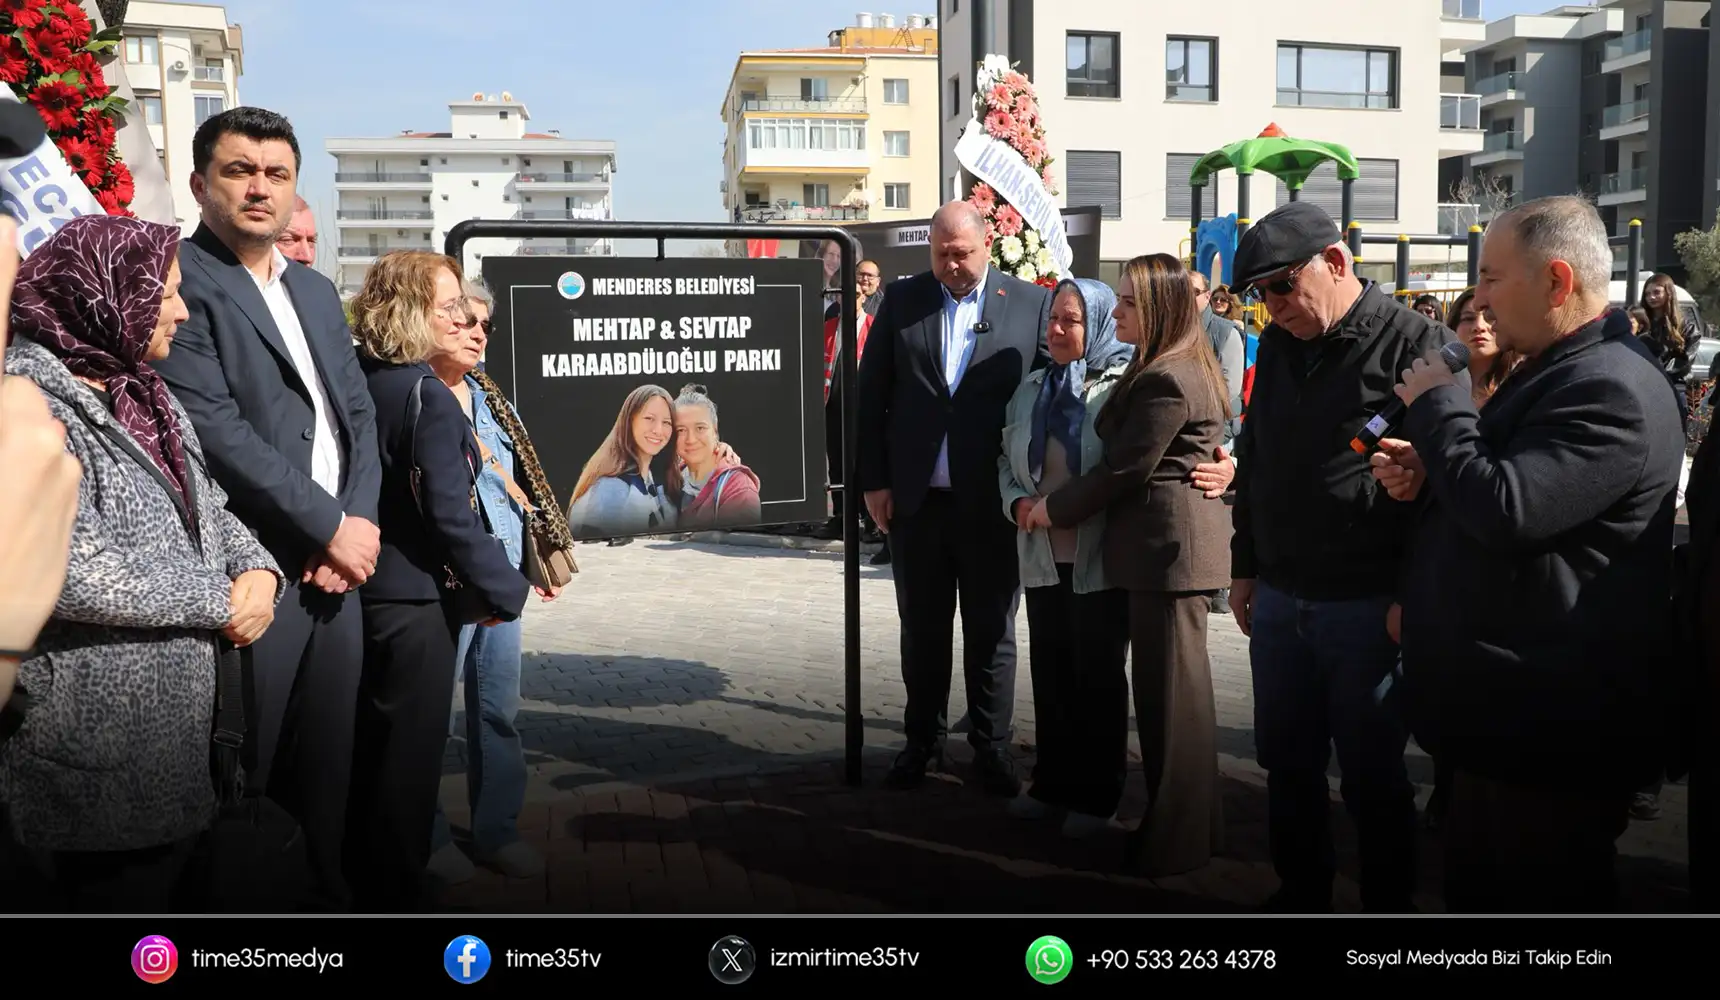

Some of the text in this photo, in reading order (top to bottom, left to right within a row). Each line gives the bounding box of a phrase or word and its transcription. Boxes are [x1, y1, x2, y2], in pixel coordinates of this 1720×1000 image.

[898, 230, 928, 242] MEHTAP
[592, 274, 755, 296] MENDERES BELEDİYESİ
[573, 316, 752, 341] MEHTAP & SEVTAP
[541, 347, 781, 377] KARAABDÜLOĞLU PARKI
